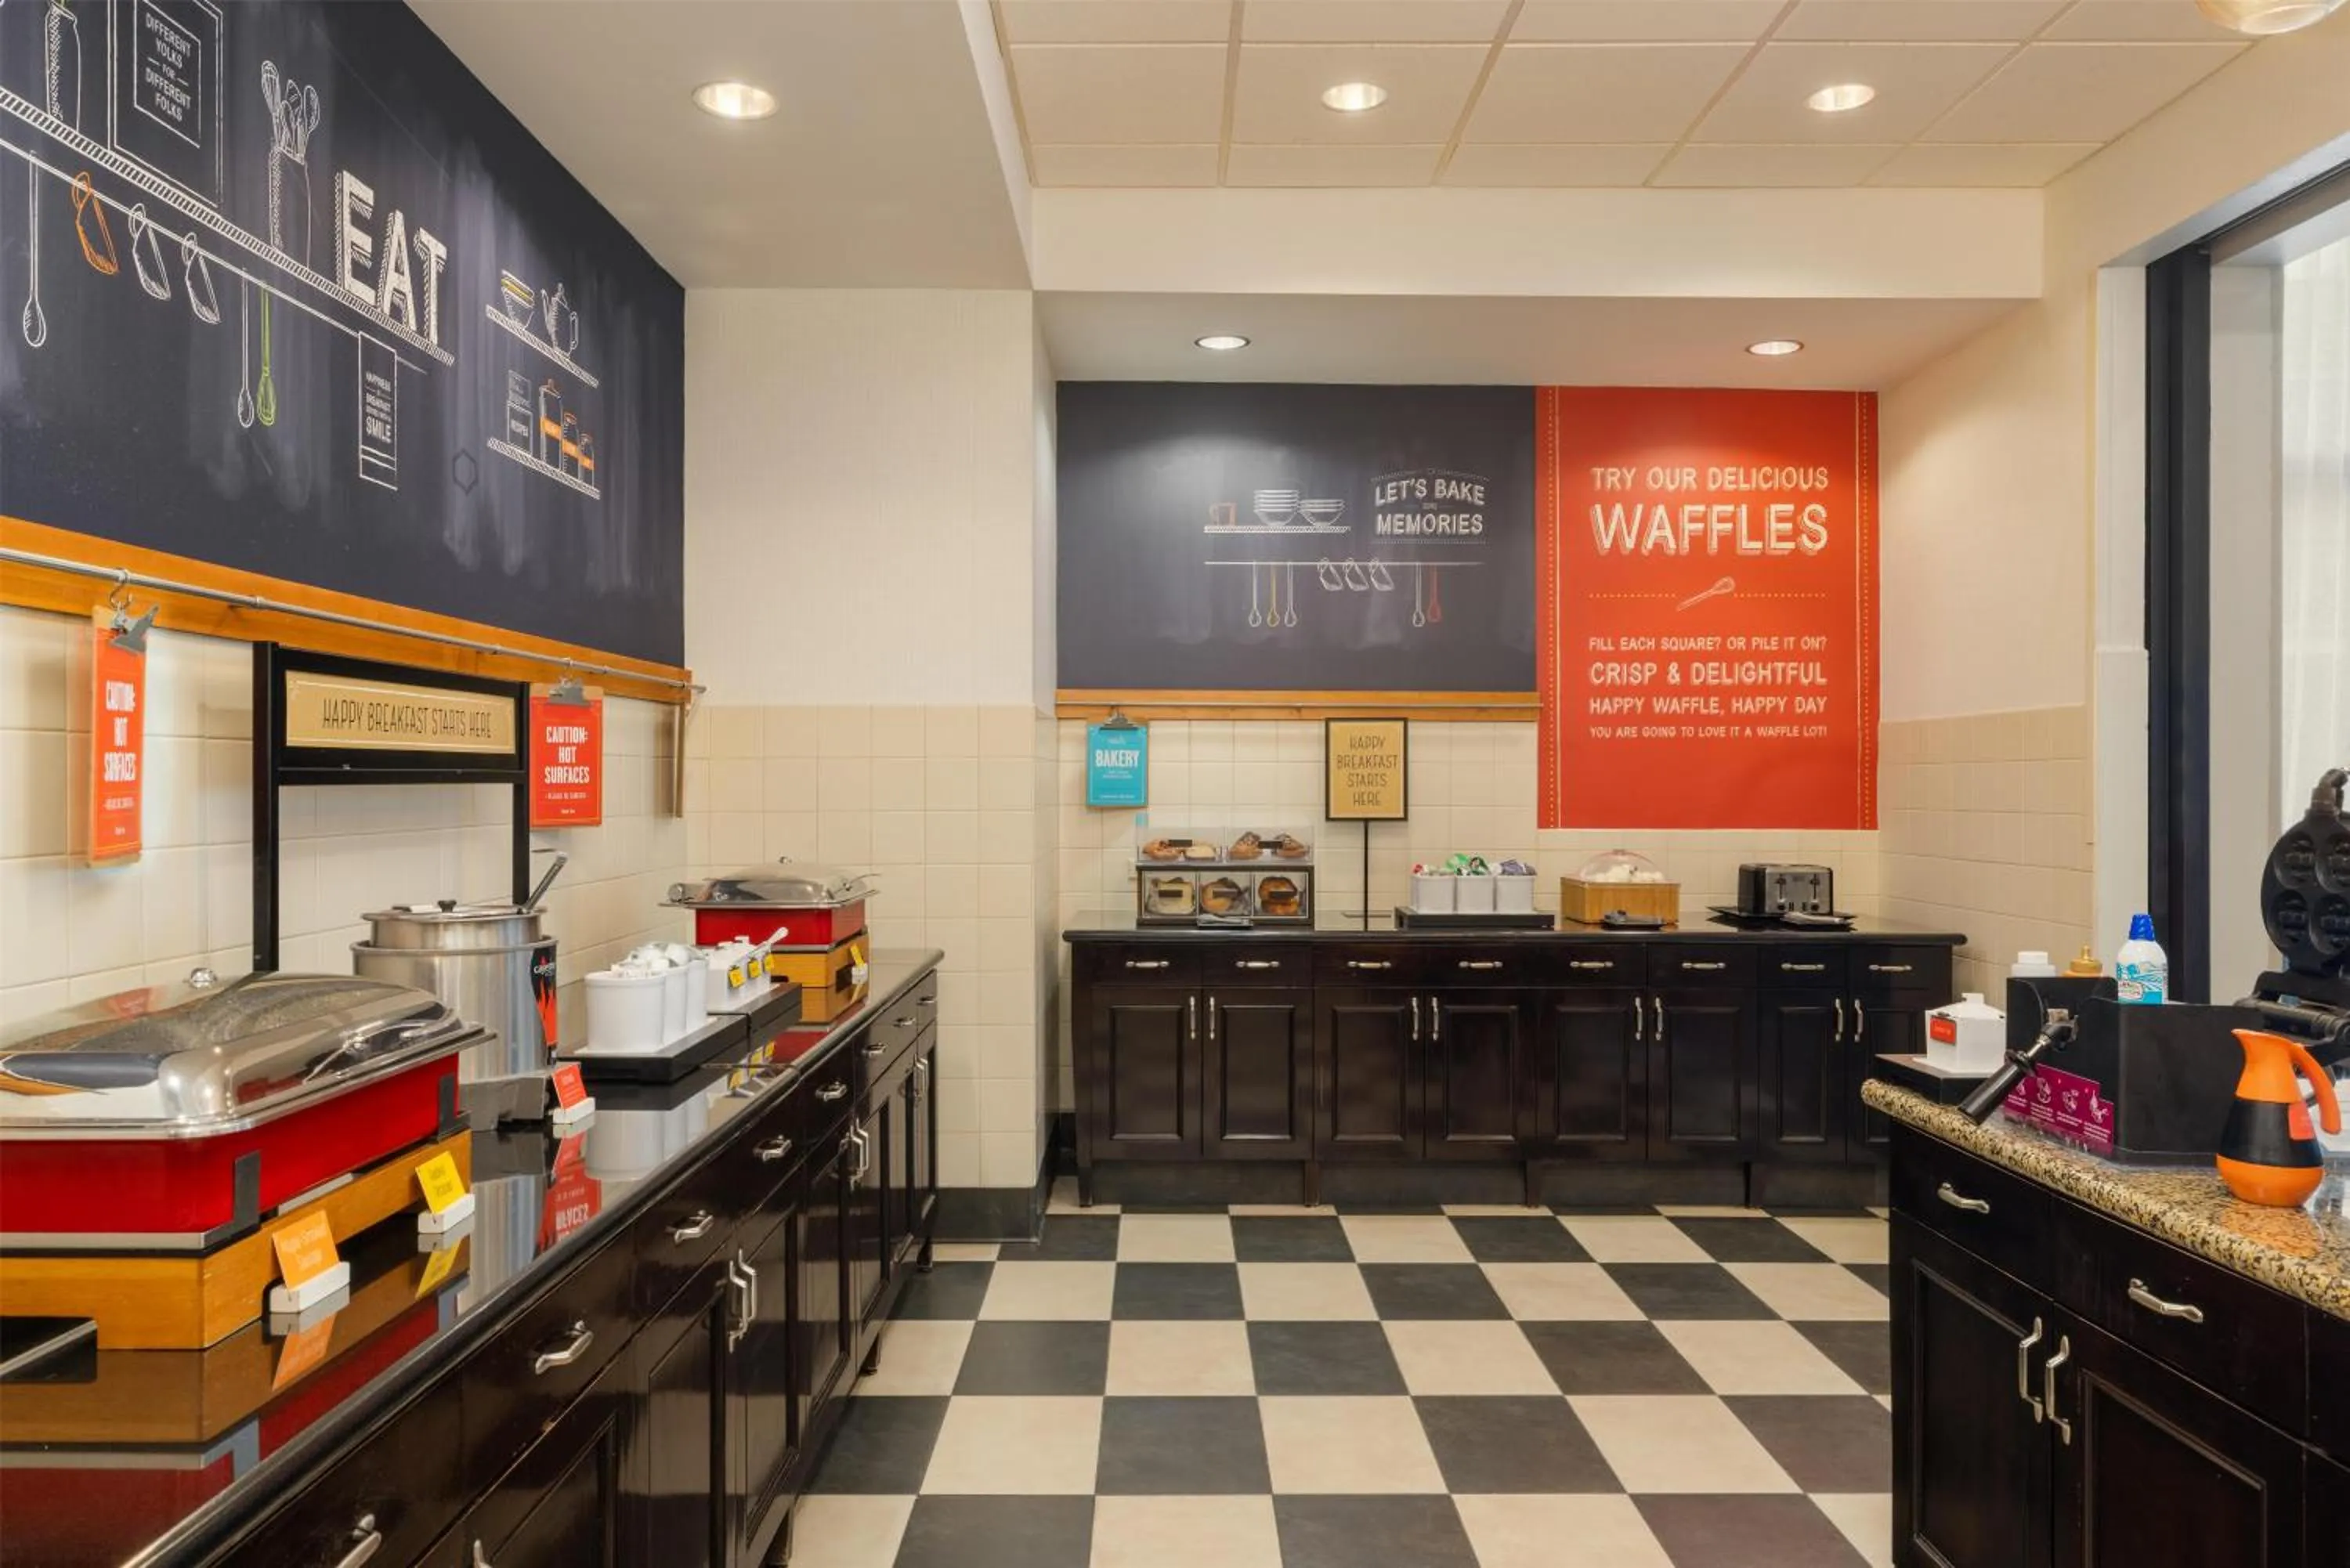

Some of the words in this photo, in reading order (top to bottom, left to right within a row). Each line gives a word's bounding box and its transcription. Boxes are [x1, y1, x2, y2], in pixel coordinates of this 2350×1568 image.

[146, 13, 191, 58] DIFFERENT
[156, 37, 183, 69] YOLKS
[146, 67, 191, 110] DIFFERENT
[156, 91, 183, 122] FOLKS
[334, 169, 447, 346] EAT
[366, 416, 392, 444] SMILE
[1591, 467, 1636, 491] TRY
[1647, 467, 1697, 492] OUR
[1707, 466, 1829, 492] DELICIOUS
[1375, 479, 1427, 508] LET'S
[1434, 479, 1485, 506] BAKE
[1376, 513, 1484, 536] MEMORIES
[1590, 503, 1829, 556] WAFFLES
[1589, 637, 1614, 651] FILL
[1620, 637, 1655, 651] EACH
[1661, 637, 1721, 651] SQUARE?
[1726, 637, 1746, 651] OR
[1752, 637, 1779, 651] PILE
[1784, 637, 1795, 651] IT
[1801, 637, 1828, 651] ON?
[1589, 662, 1658, 686] CRISP
[1667, 662, 1681, 686] &
[1690, 662, 1828, 686] DELIGHTFUL
[1589, 697, 1644, 714] HAPPY
[1653, 697, 1724, 717] WAFFLE,
[1731, 697, 1788, 714] HAPPY
[1795, 696, 1828, 714] DAY
[322, 699, 364, 730] HAPPY
[367, 703, 428, 735] BREAKFAST
[432, 708, 466, 736] STARTS
[470, 710, 492, 739] HERE
[546, 726, 589, 743] CAUTION:
[1349, 735, 1386, 750] HAPPY
[1590, 726, 1611, 738] YOU
[1616, 726, 1637, 738] ARE
[1642, 726, 1676, 738] GOING
[1681, 726, 1694, 738] TO
[1698, 726, 1726, 738] LOVE
[1730, 726, 1740, 738] IT
[1744, 726, 1752, 738] A
[1757, 726, 1800, 738] WAFFLE
[1803, 726, 1828, 738] LOT!
[558, 746, 577, 764] HOT
[1095, 750, 1141, 768] BAKERY
[1336, 754, 1398, 768] BREAKFAST
[544, 766, 590, 784] SURFACES
[1347, 772, 1387, 787] STARTS
[1353, 791, 1381, 806] HERE
